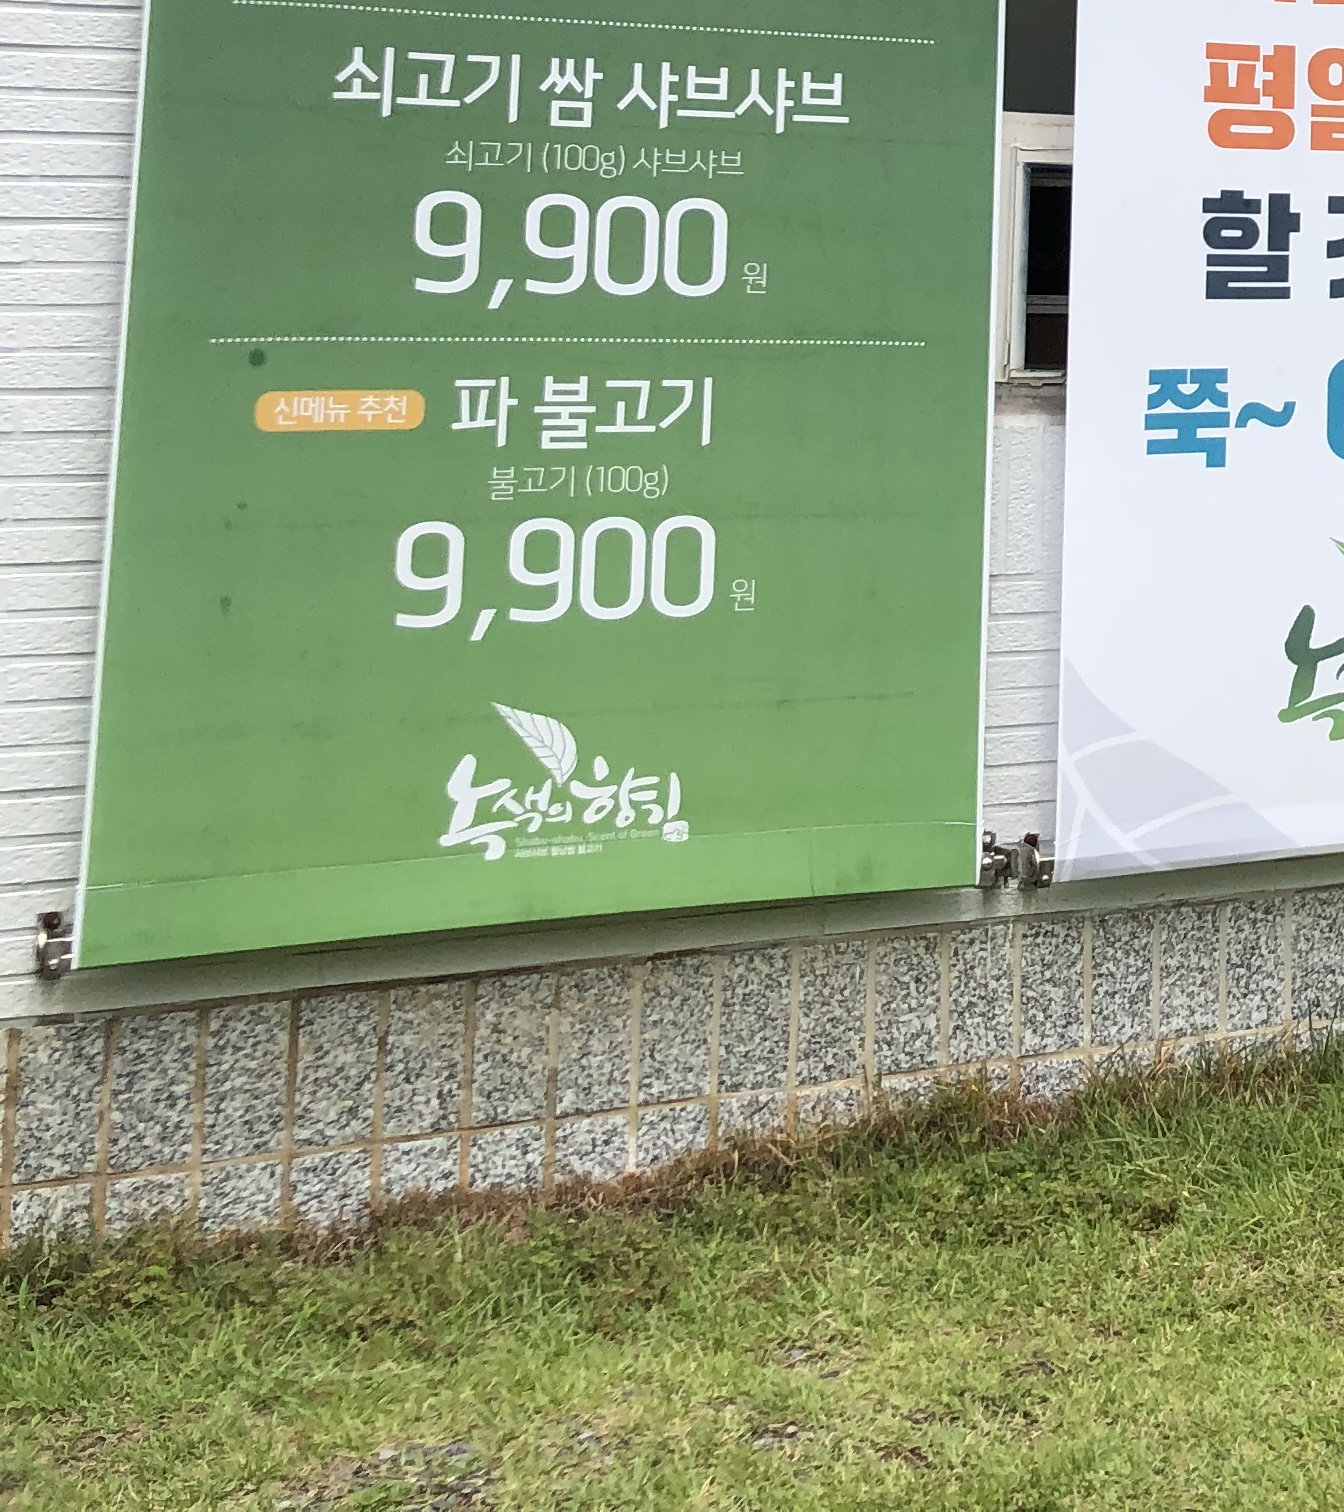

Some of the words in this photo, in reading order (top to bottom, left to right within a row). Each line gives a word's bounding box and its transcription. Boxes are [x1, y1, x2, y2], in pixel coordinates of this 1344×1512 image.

[332, 46, 520, 123] 쇠고기
[538, 58, 604, 129] 쌈
[616, 61, 851, 134] 샤브샤브
[632, 147, 746, 180] 샤브샤브
[412, 189, 729, 310] 9,900
[741, 262, 768, 295] 원
[1201, 190, 1301, 300] 할
[273, 395, 351, 426] 신메뉴
[356, 394, 408, 425] 추천
[451, 376, 518, 448] 파
[533, 376, 714, 450] 불고기
[1144, 367, 1296, 468] 쭉~
[393, 515, 717, 643] 9,900
[729, 578, 756, 613] 원
